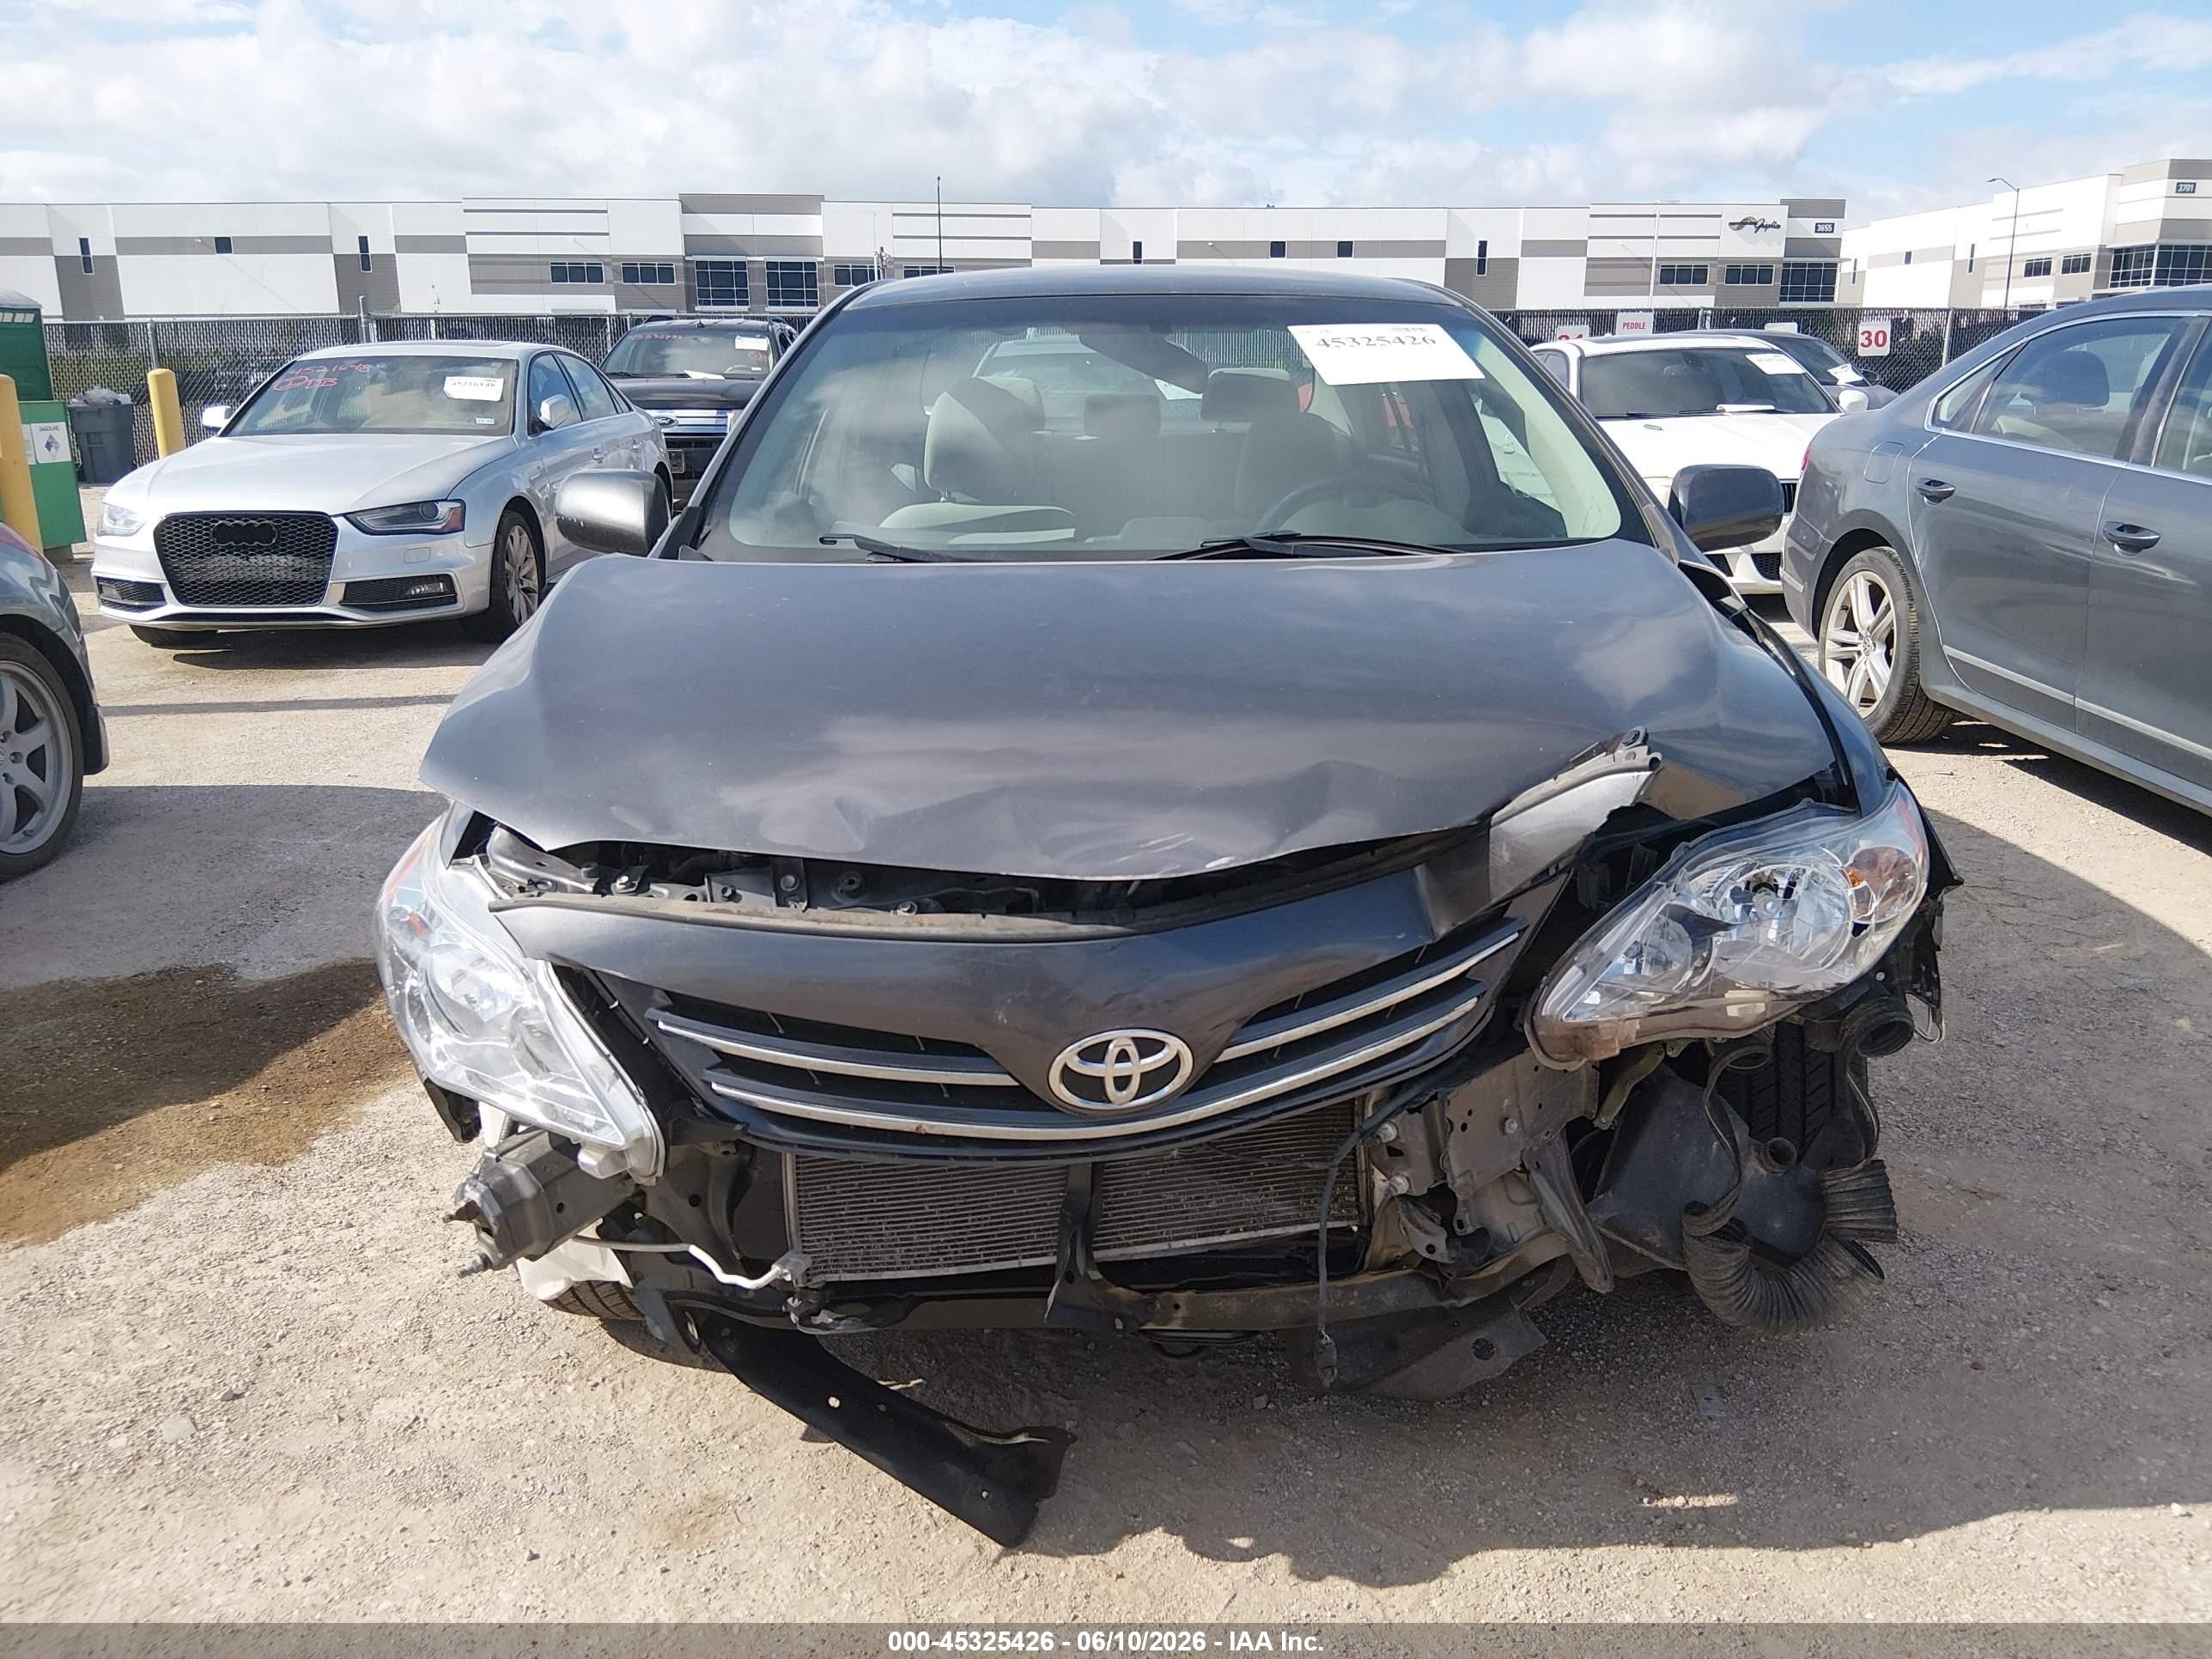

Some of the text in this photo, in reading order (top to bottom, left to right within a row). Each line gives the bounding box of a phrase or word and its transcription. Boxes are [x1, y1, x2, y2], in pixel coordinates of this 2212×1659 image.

[1816, 223, 1834, 232] 3655
[1316, 335, 1437, 349] 45325426
[1860, 330, 1887, 348] 30
